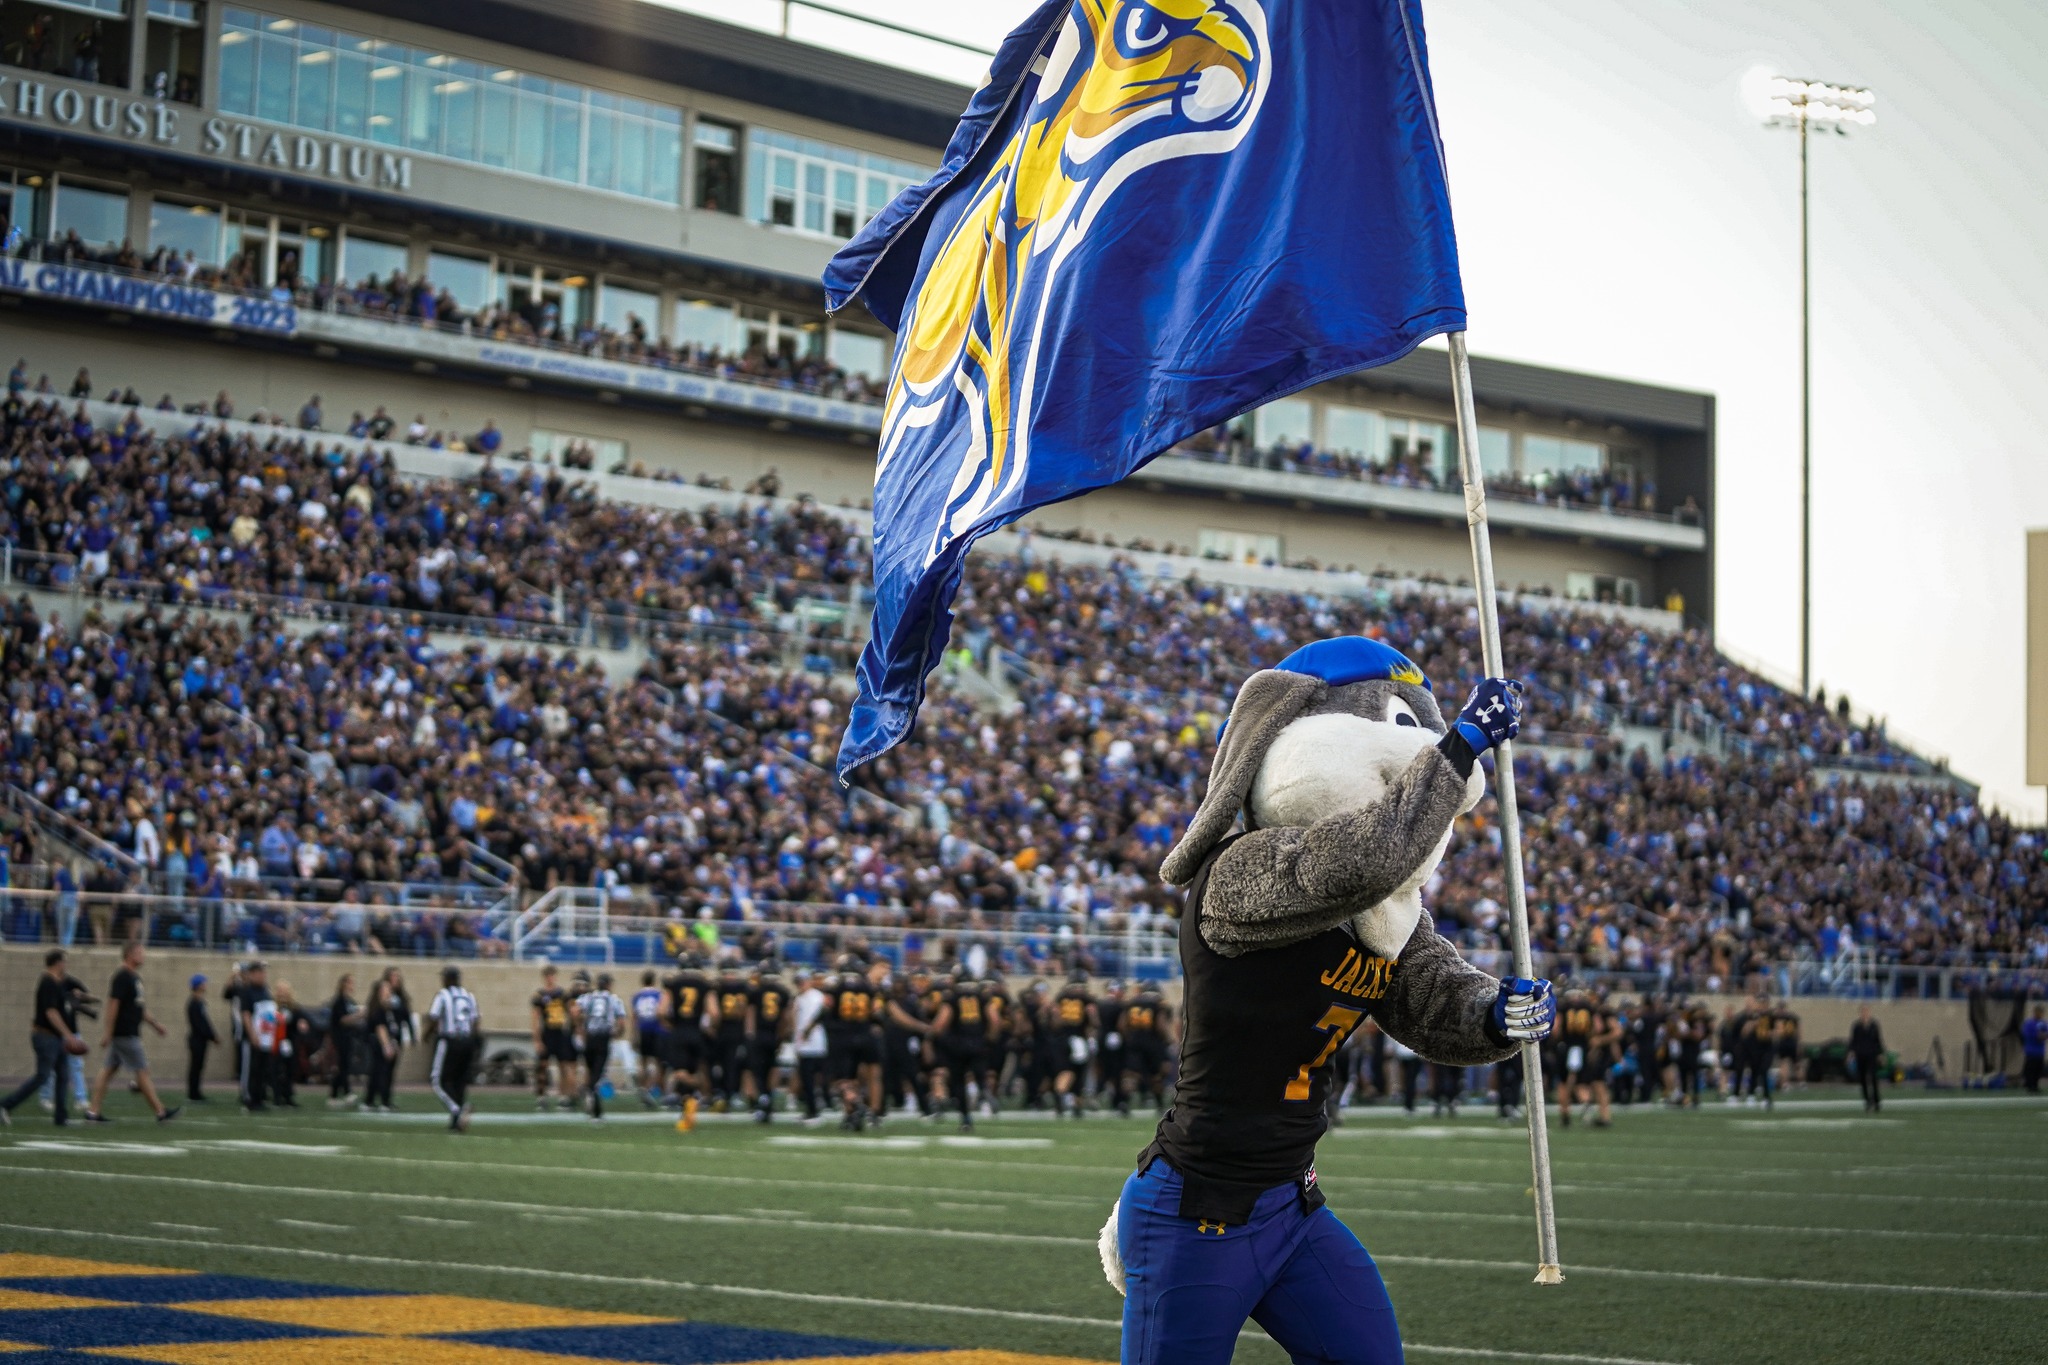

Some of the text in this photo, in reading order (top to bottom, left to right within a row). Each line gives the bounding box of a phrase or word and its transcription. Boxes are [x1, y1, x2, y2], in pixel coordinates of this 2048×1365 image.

[0, 76, 412, 190] HOUSE STADIUM
[35, 265, 217, 320] CHAMPIONS
[232, 296, 297, 334] 2023
[1321, 947, 1399, 999] JACKS
[1283, 1001, 1367, 1102] 7
